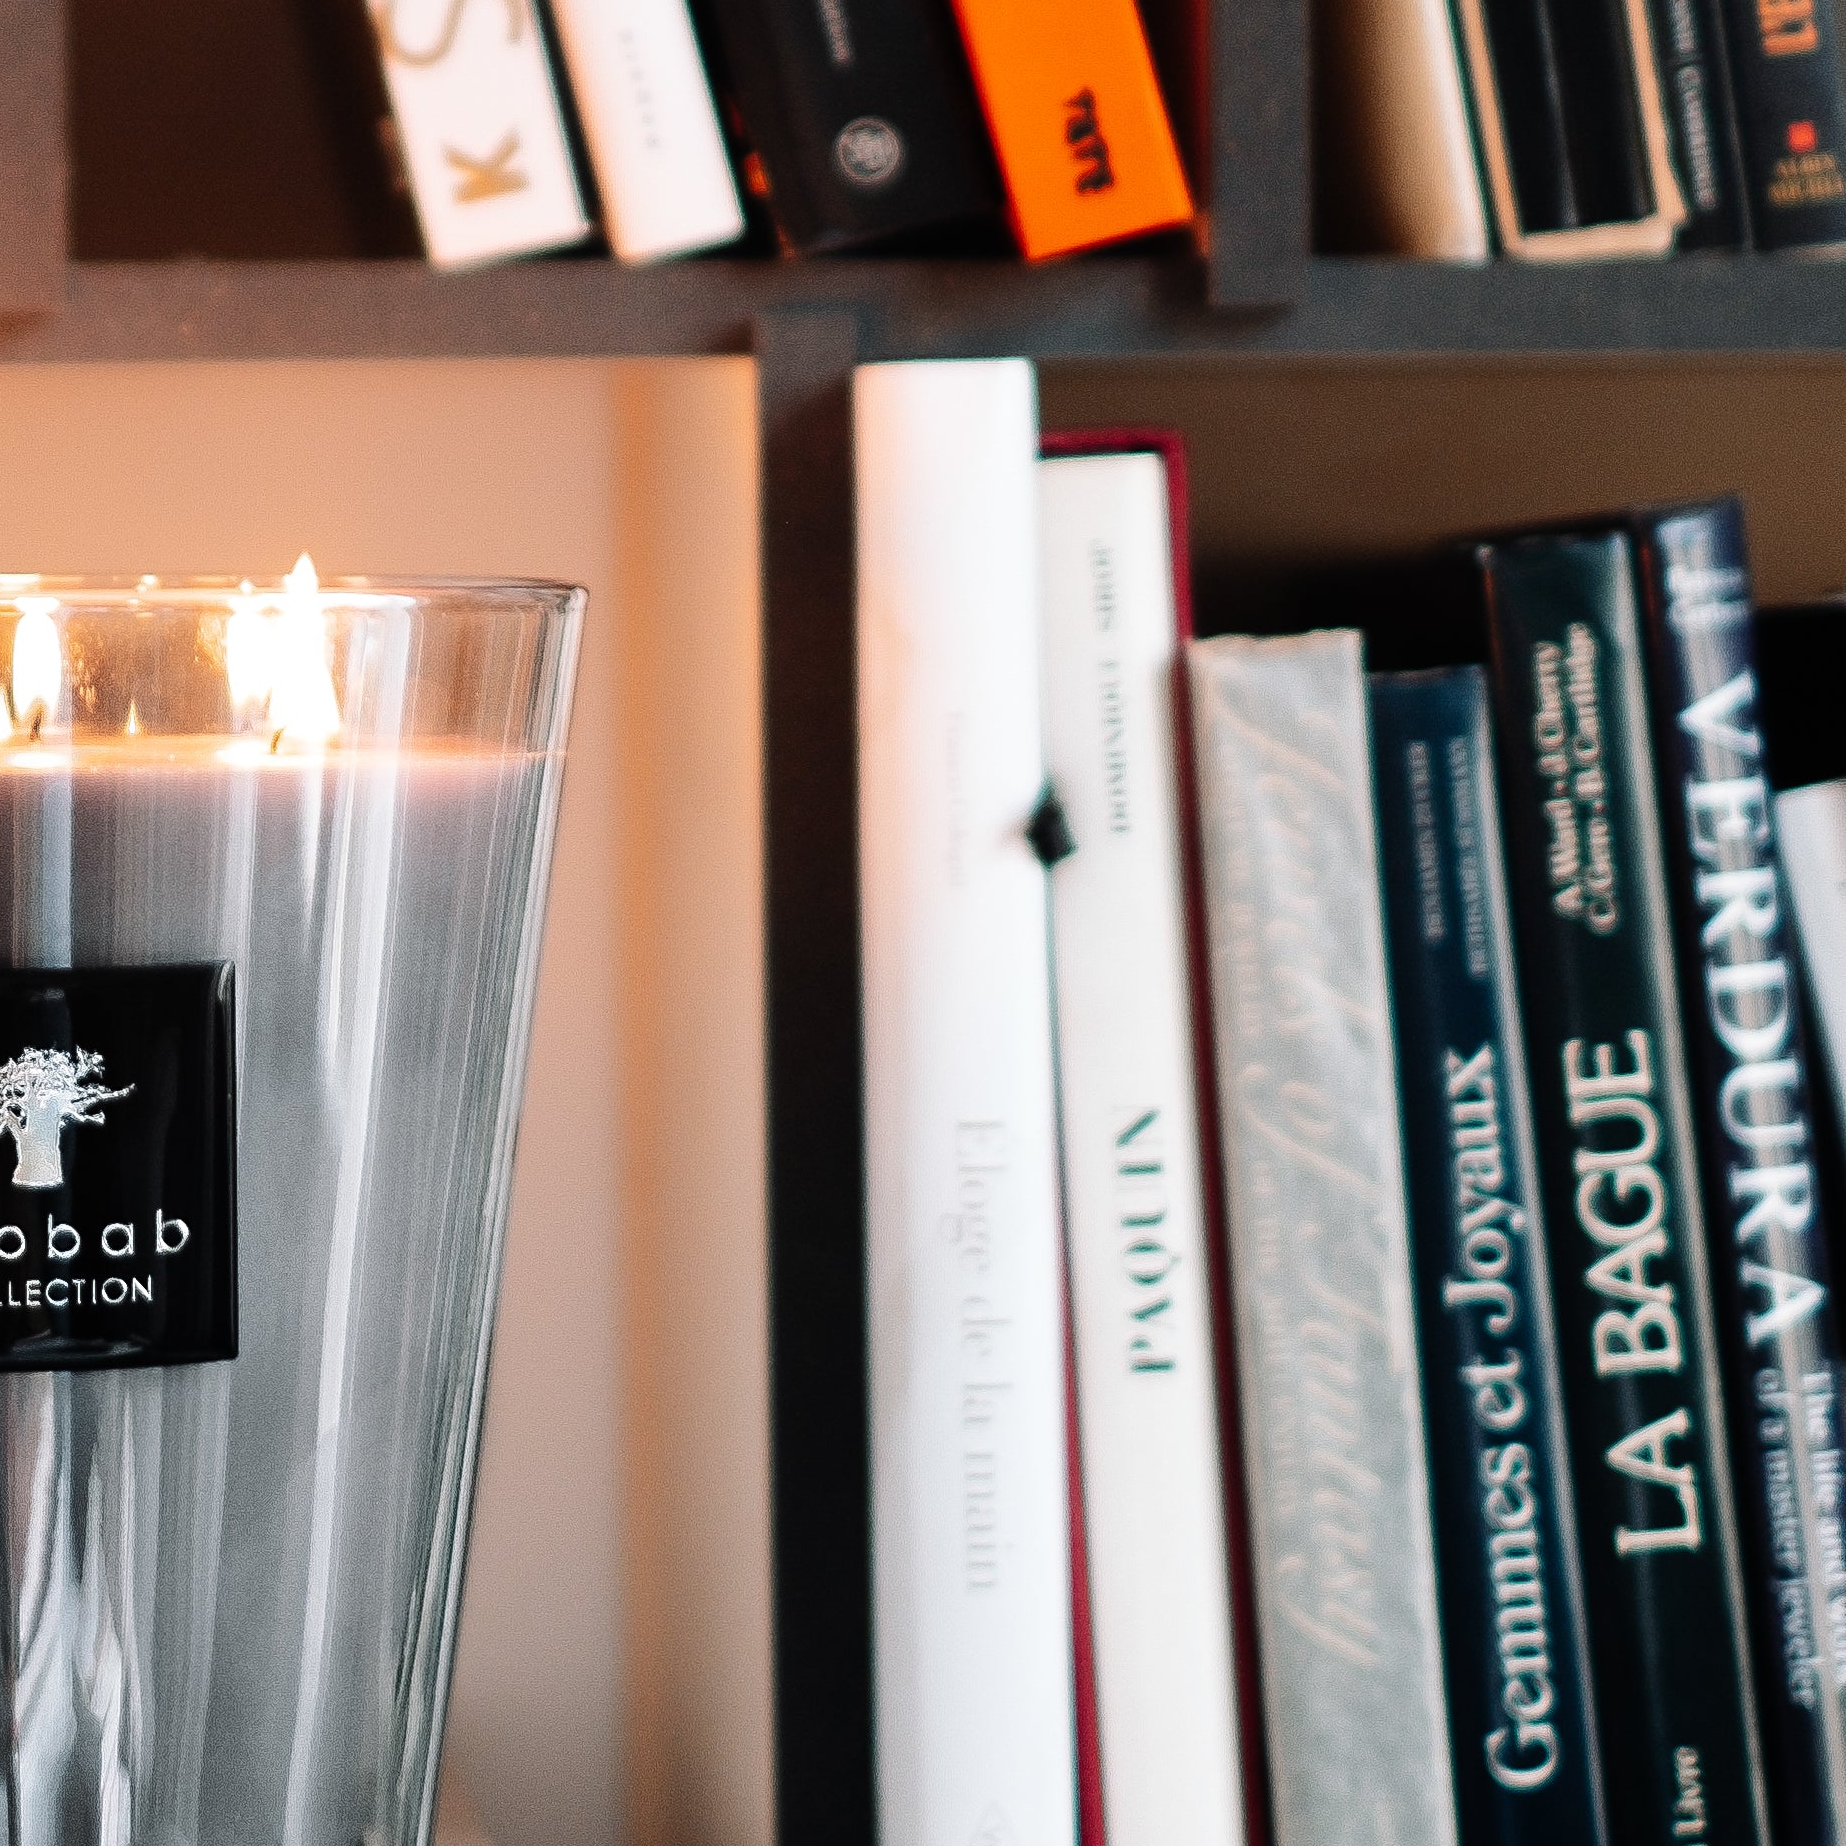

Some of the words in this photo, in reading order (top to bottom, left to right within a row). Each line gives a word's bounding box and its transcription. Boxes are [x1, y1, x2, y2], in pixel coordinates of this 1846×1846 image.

[1678, 671, 1826, 1350] VERDURA
[1114, 1106, 1181, 1375] PAQUIN
[1443, 1042, 1530, 1335] Joyaux
[1563, 1027, 1684, 1374] BAGUE
[961, 1289, 1012, 1368] de
[1462, 1347, 1530, 1432] et
[963, 1380, 1014, 1429] la
[963, 1448, 1016, 1595] main
[1606, 1407, 1701, 1555] LA
[1480, 1440, 1560, 1792] Gemmes
[1673, 1745, 1707, 1838] Livre
